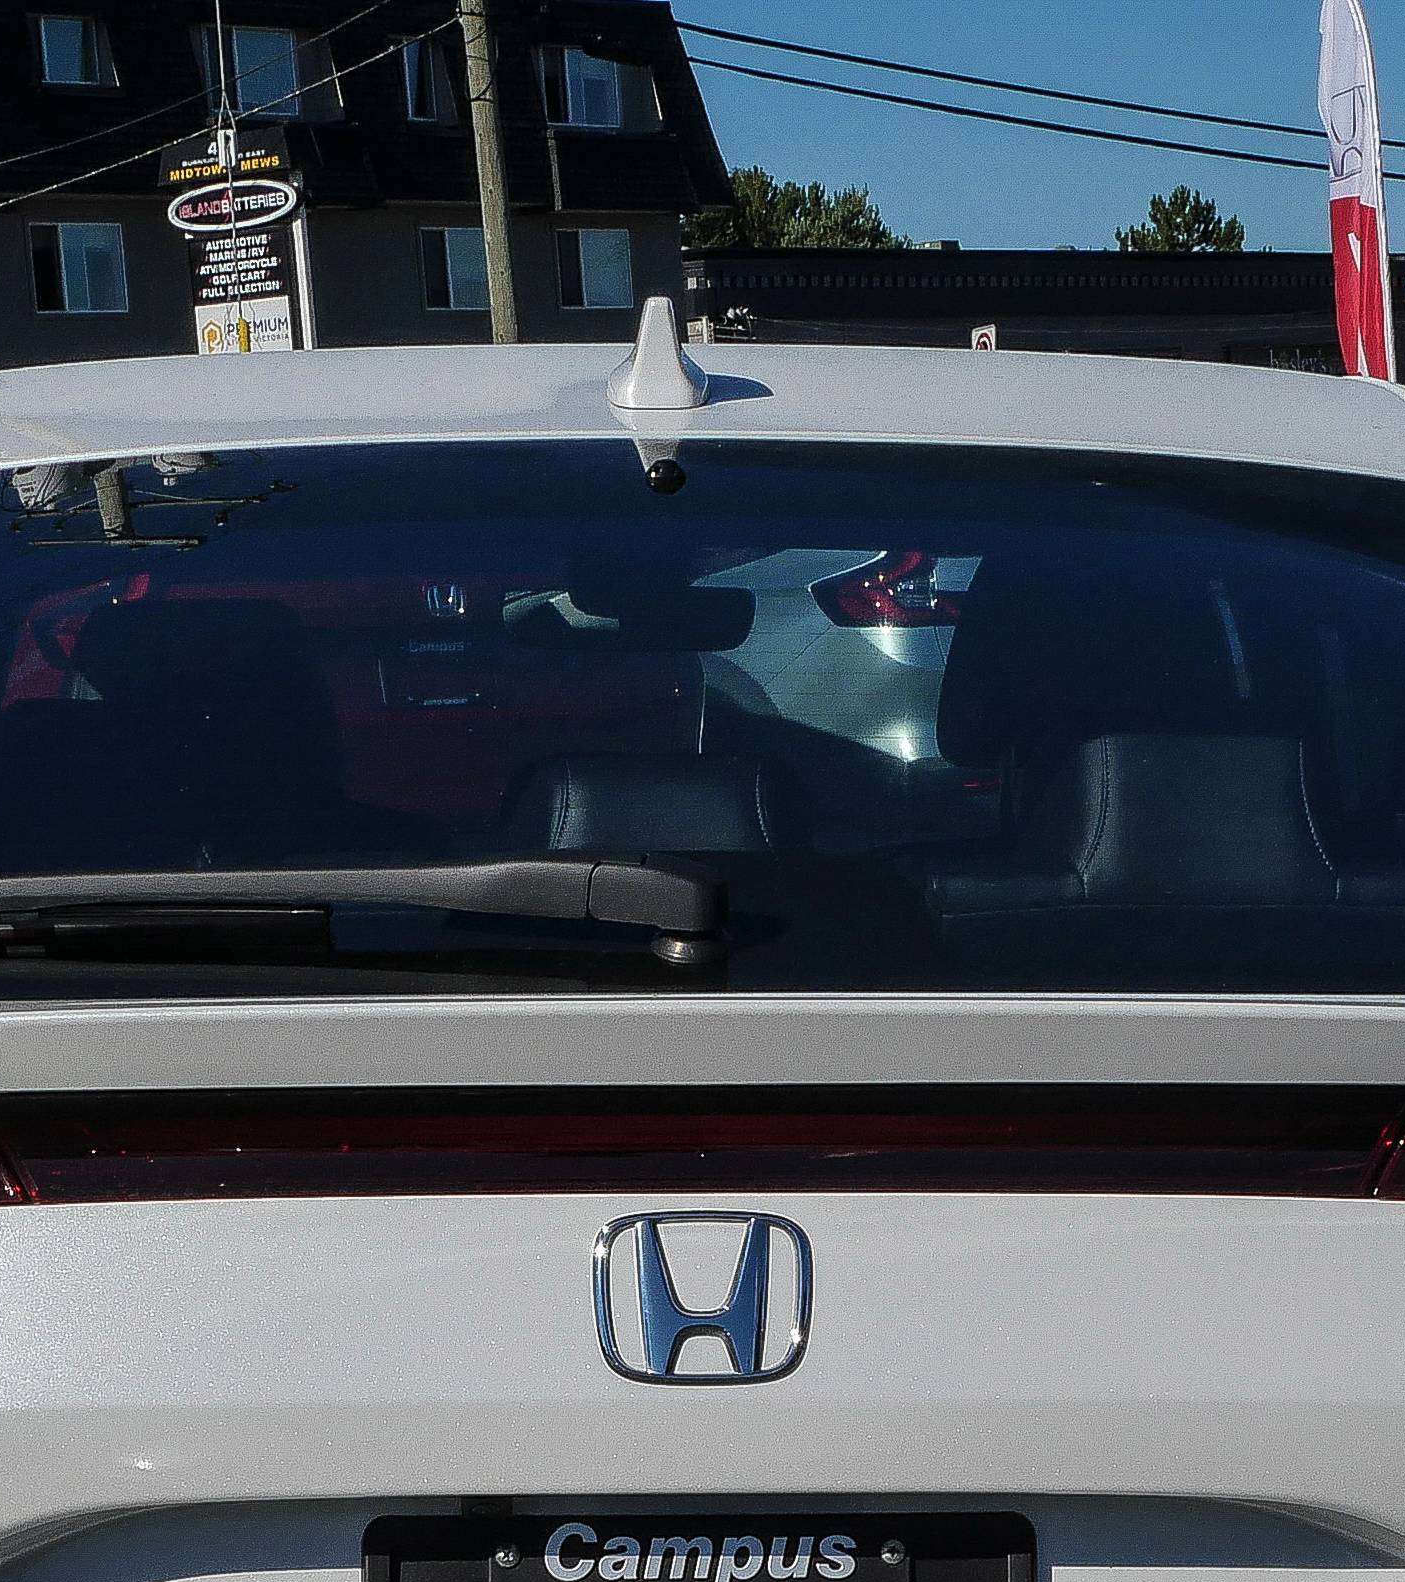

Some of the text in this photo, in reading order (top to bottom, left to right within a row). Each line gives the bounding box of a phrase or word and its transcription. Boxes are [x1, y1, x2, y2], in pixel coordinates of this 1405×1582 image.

[169, 164, 227, 182] MIDTOW
[240, 155, 280, 172] MEWS
[212, 270, 266, 286] GOLF CART
[201, 286, 226, 299] FULL
[226, 316, 289, 336] PMIUM
